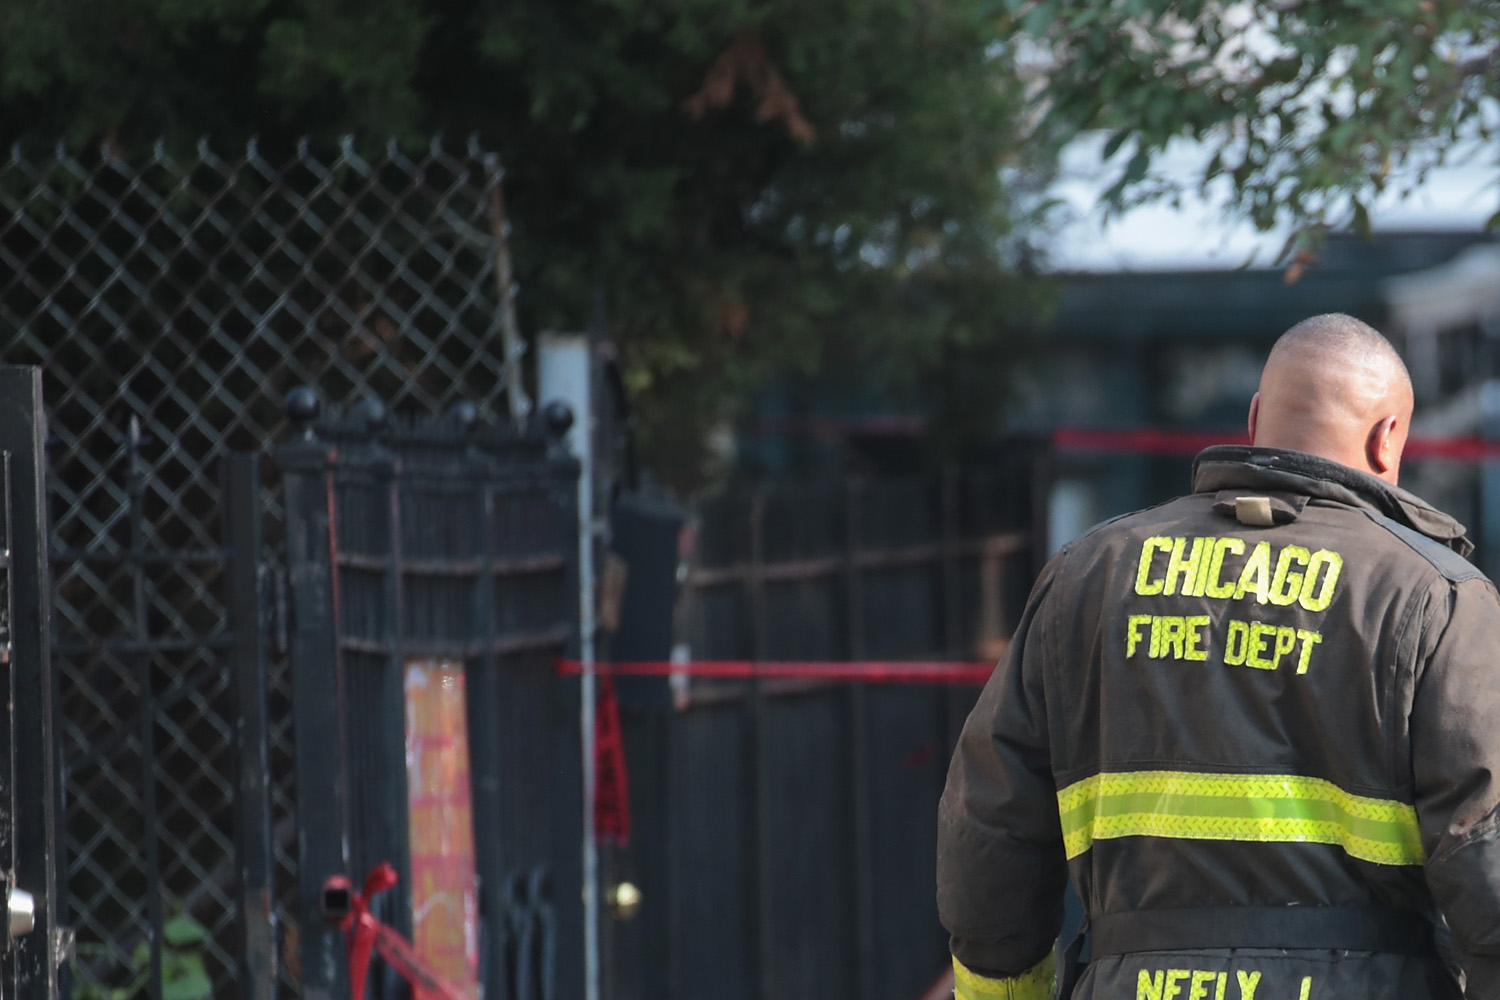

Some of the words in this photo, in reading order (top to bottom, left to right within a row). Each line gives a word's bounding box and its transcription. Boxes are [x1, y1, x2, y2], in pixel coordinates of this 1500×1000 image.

[1134, 535, 1344, 612] CHICAGO
[1126, 614, 1210, 661] FIRE
[1223, 619, 1323, 675] DEPT
